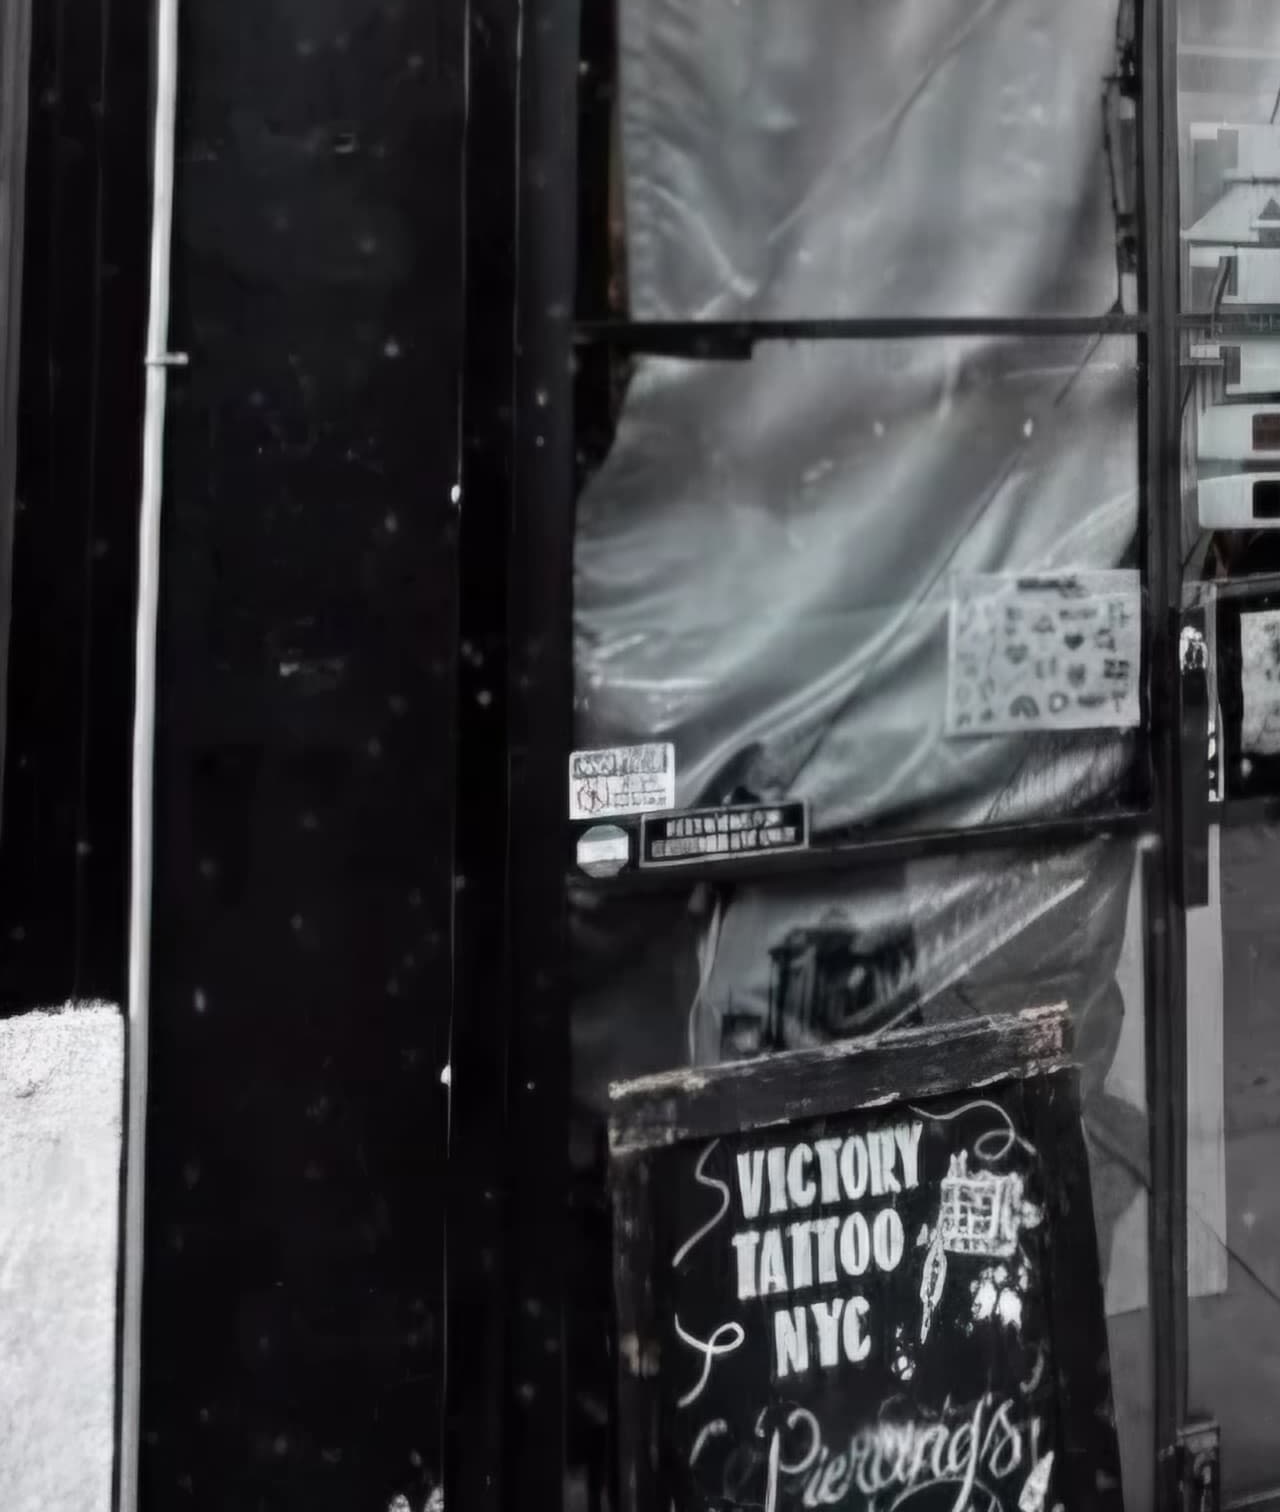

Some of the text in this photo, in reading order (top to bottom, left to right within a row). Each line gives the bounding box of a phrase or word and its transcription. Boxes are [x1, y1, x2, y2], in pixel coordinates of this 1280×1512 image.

[736, 1121, 924, 1220] VICTORY
[731, 1207, 905, 1300] TATTOO
[773, 1295, 872, 1378] NYC
